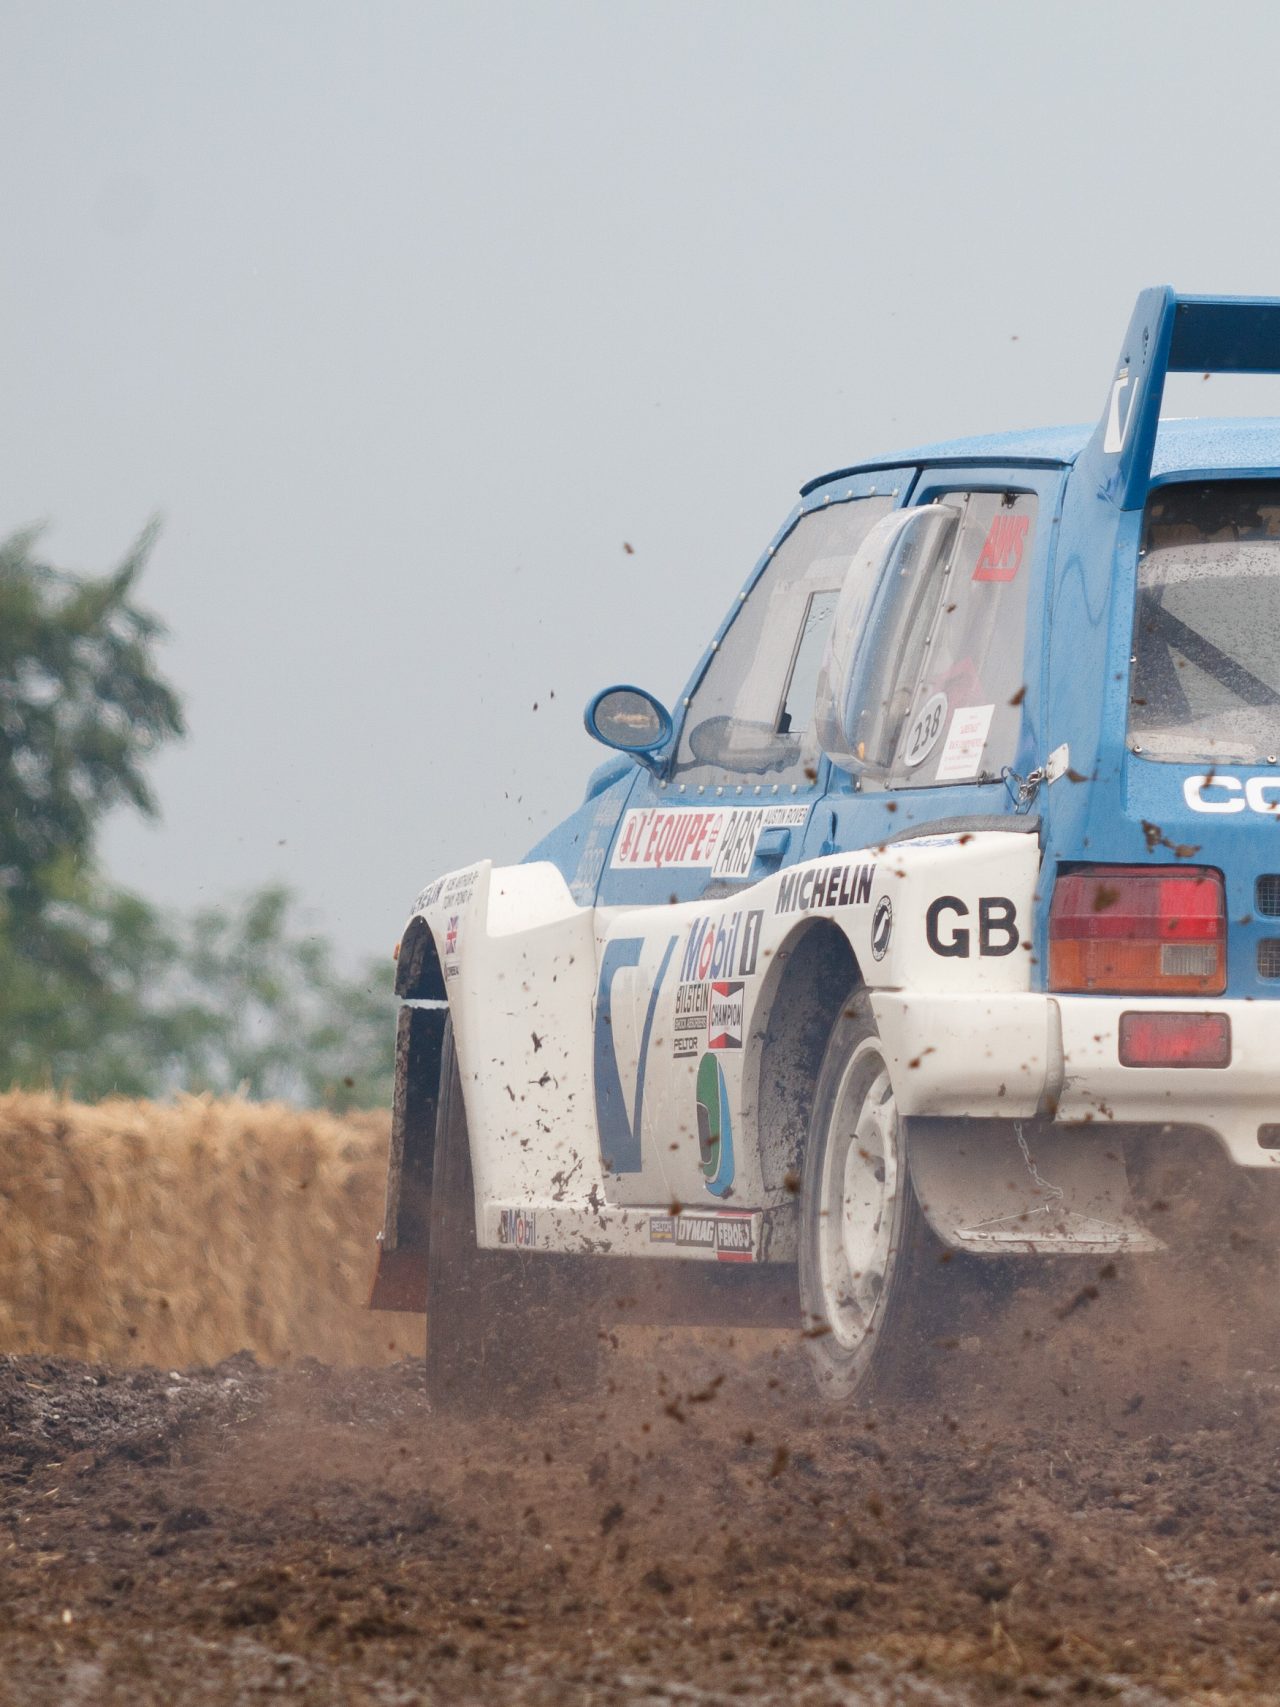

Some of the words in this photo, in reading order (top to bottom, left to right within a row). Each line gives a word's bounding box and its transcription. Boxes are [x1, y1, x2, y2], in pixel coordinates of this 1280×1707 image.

[911, 704, 941, 756] 238
[630, 809, 716, 868] L'EQUIPE
[713, 809, 764, 874] PARIS
[775, 863, 877, 914] MICHELIN
[680, 911, 742, 981] Mobil
[926, 895, 1020, 958] GB
[675, 983, 710, 1014] BILSTEIN
[711, 1004, 742, 1026] CHAMPION
[674, 1037, 698, 1051] PELTOR
[678, 1220, 715, 1241] DYMAG
